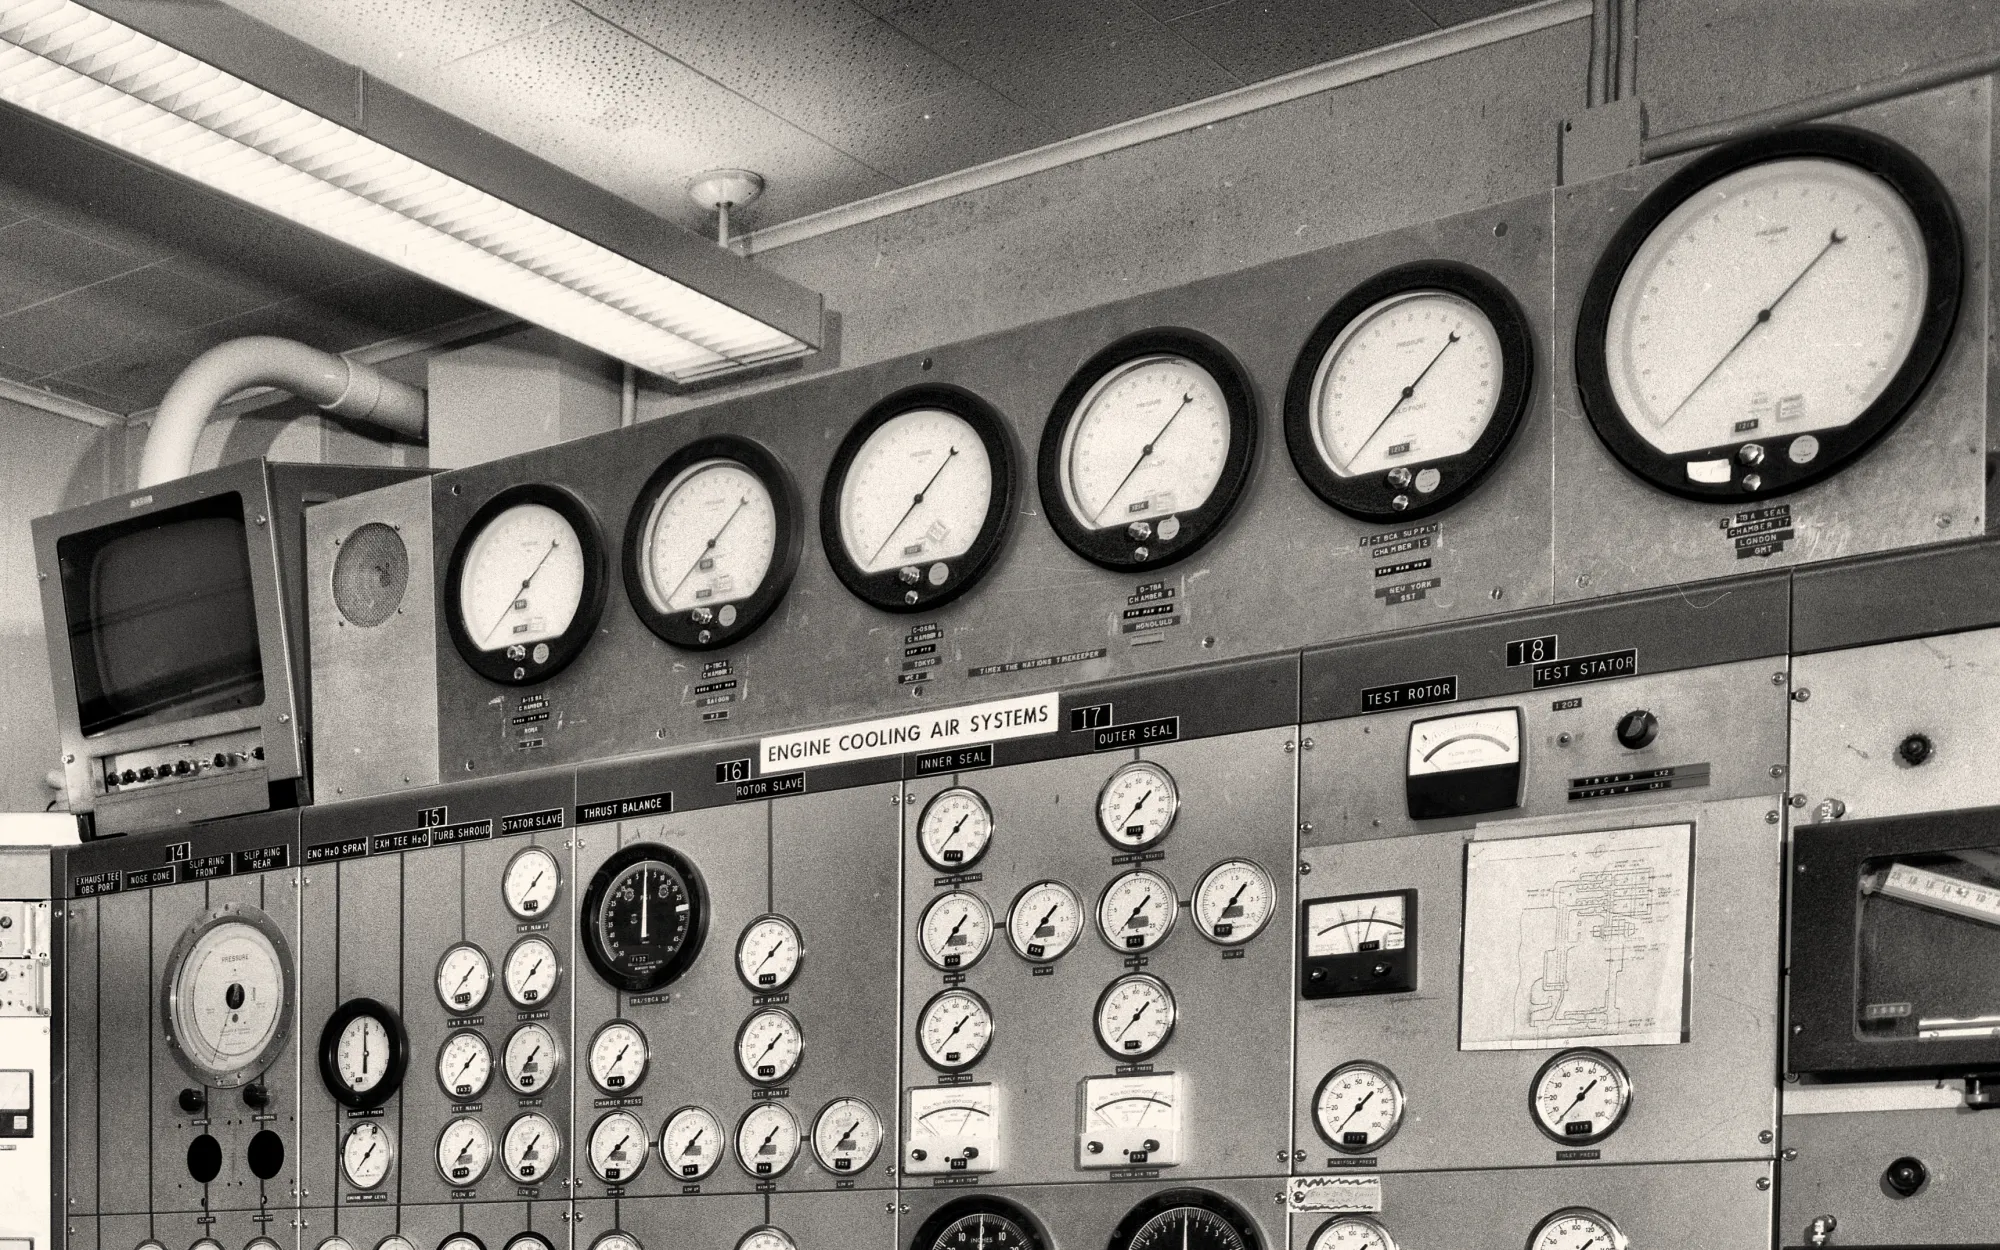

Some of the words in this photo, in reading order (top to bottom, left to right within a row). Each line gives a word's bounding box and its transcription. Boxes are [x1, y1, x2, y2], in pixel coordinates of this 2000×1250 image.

[1764, 508, 1786, 516] SEAL
[1403, 525, 1437, 537] SUPPLY
[1730, 522, 1772, 536] CHAMBER
[1778, 518, 1789, 527] 17
[1740, 535, 1777, 546] LONDON
[1374, 542, 1412, 556] CHAMBER
[1754, 545, 1772, 554] GMT
[1389, 586, 1405, 594] NEW
[1411, 581, 1432, 590] YORK
[1129, 592, 1162, 604] CHAMBER
[1400, 593, 1416, 602] SST
[1136, 618, 1172, 630] HONOLULU
[1518, 639, 1544, 664] 18
[914, 658, 935, 668] TOKYO
[980, 666, 1001, 675] TIMEX
[1022, 659, 1052, 669] NATIONS
[1057, 650, 1099, 663] TIMEKEEPER
[1536, 666, 1570, 681] TEST
[1580, 656, 1634, 675] STATOR
[1368, 691, 1400, 705] TEST
[1408, 684, 1450, 700] ROTOR
[1556, 700, 1578, 709] 1202
[1080, 708, 1101, 729] 17
[768, 738, 831, 762] ENGINE
[839, 725, 920, 751] COOLING
[931, 718, 960, 739] AIR
[970, 705, 1049, 733] SYSTEMS
[1100, 729, 1136, 745] OUTER
[1144, 724, 1173, 739] SEAL
[920, 755, 952, 769] INNER
[960, 751, 986, 764] SEAL
[724, 762, 742, 781] 16
[736, 782, 767, 796] ROTOR
[773, 778, 803, 791] SLAVE
[584, 804, 618, 819] THRUST
[622, 798, 662, 814] BALANCE
[424, 809, 440, 827] 15
[502, 817, 534, 831] STATOR
[536, 812, 562, 826] SLAVE
[458, 824, 491, 837] SHROUD
[375, 838, 390, 850] EXH
[394, 837, 408, 846] TEE
[171, 844, 184, 862] 14
[244, 850, 260, 860] SLIP
[264, 847, 281, 858] RING
[308, 847, 322, 859] ENG
[342, 842, 367, 854] SPRAY
[190, 859, 204, 869] SLIP
[208, 856, 225, 866] RING
[253, 858, 272, 869] REAR
[130, 874, 149, 884] NOSE
[152, 870, 170, 882] CONE
[196, 866, 218, 878] FRONT
[76, 874, 106, 886] EXHAUST
[107, 872, 120, 882] TEE
[82, 884, 94, 894] OBS
[98, 882, 114, 893] PORT
[958, 1232, 966, 1241] 10
[999, 1232, 1006, 1241] 10
